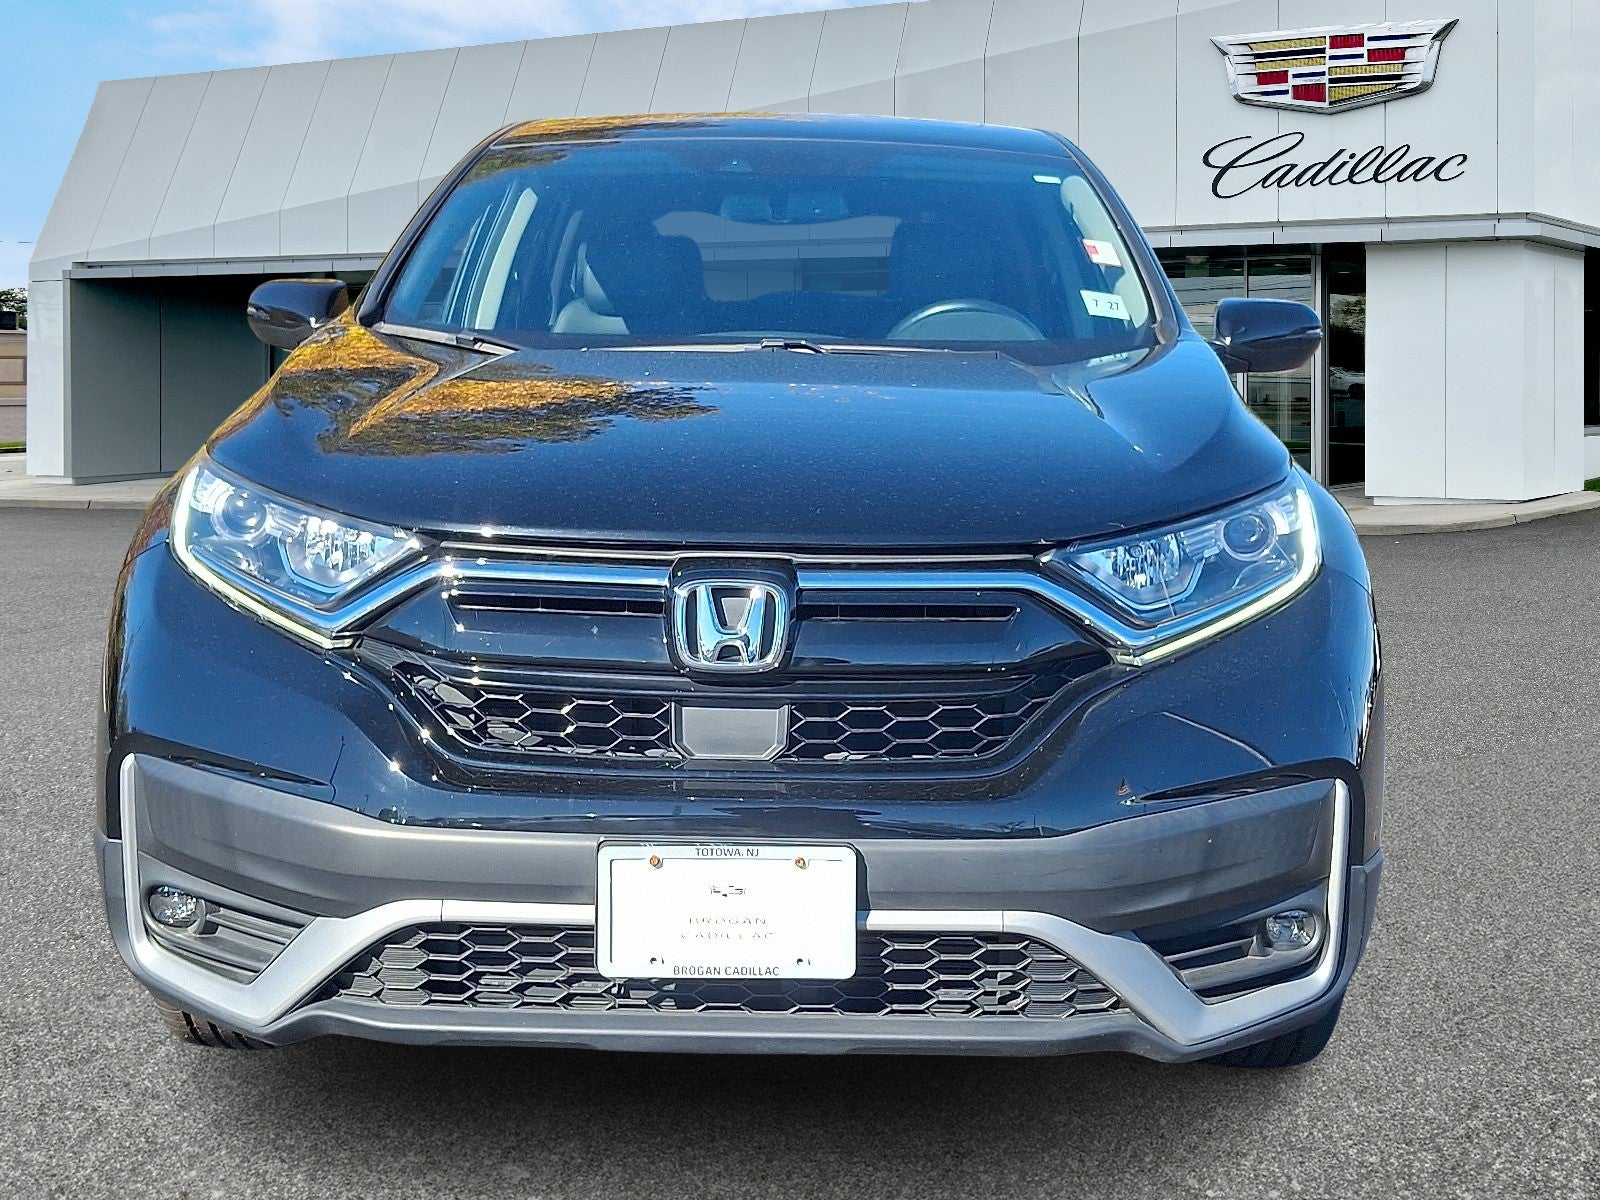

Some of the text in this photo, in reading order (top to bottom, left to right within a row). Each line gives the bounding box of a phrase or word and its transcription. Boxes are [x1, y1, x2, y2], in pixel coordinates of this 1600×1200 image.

[1202, 131, 1468, 199] Cadillac
[746, 847, 760, 858] NJ
[673, 965, 780, 977] BROGAN CADILLAC
